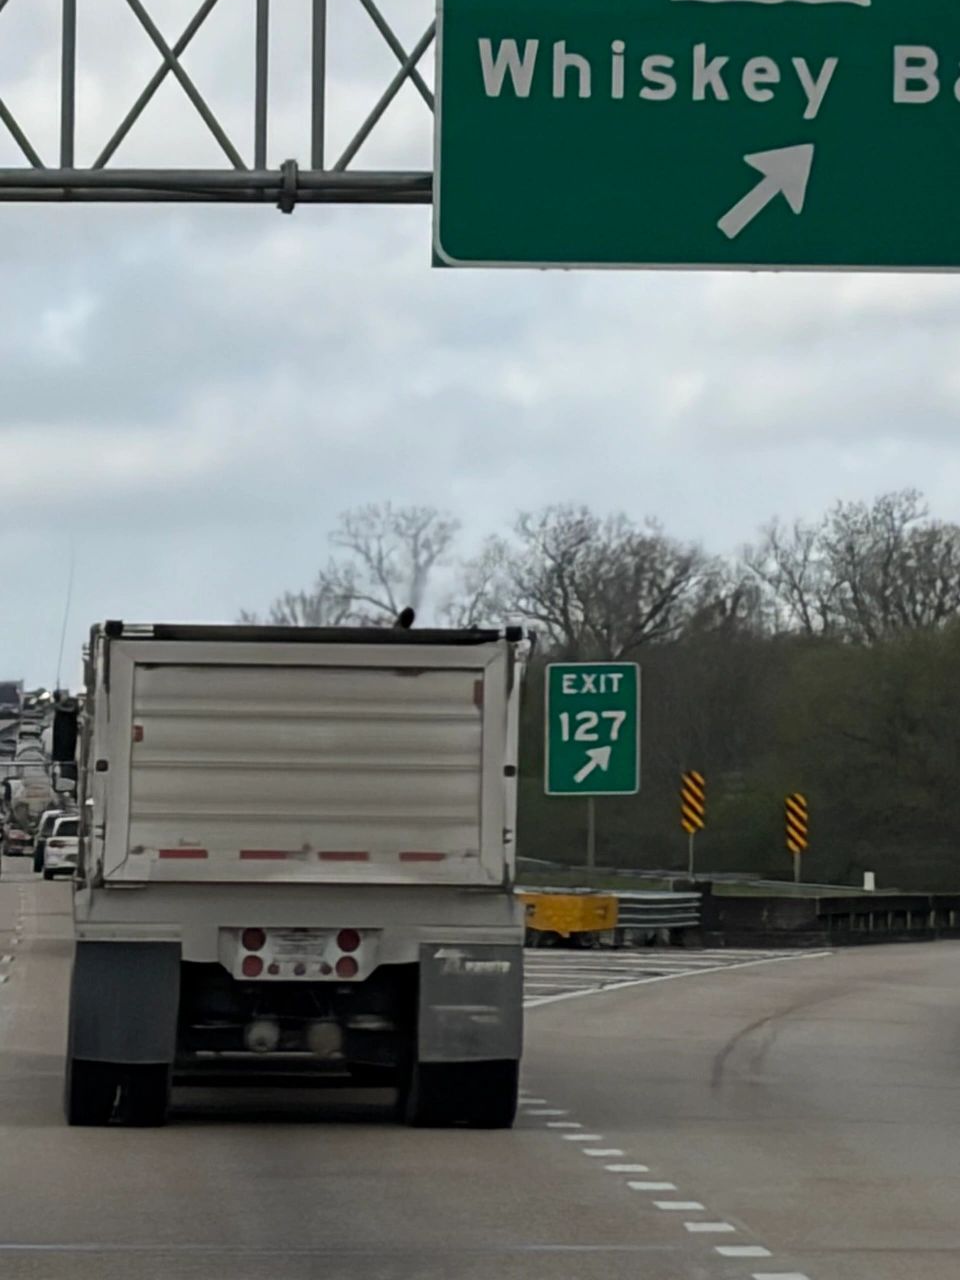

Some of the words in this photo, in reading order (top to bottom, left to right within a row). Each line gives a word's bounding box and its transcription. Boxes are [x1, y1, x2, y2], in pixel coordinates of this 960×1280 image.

[478, 38, 838, 119] Whiskey
[562, 673, 624, 694] EXIT
[559, 710, 627, 742] 127
